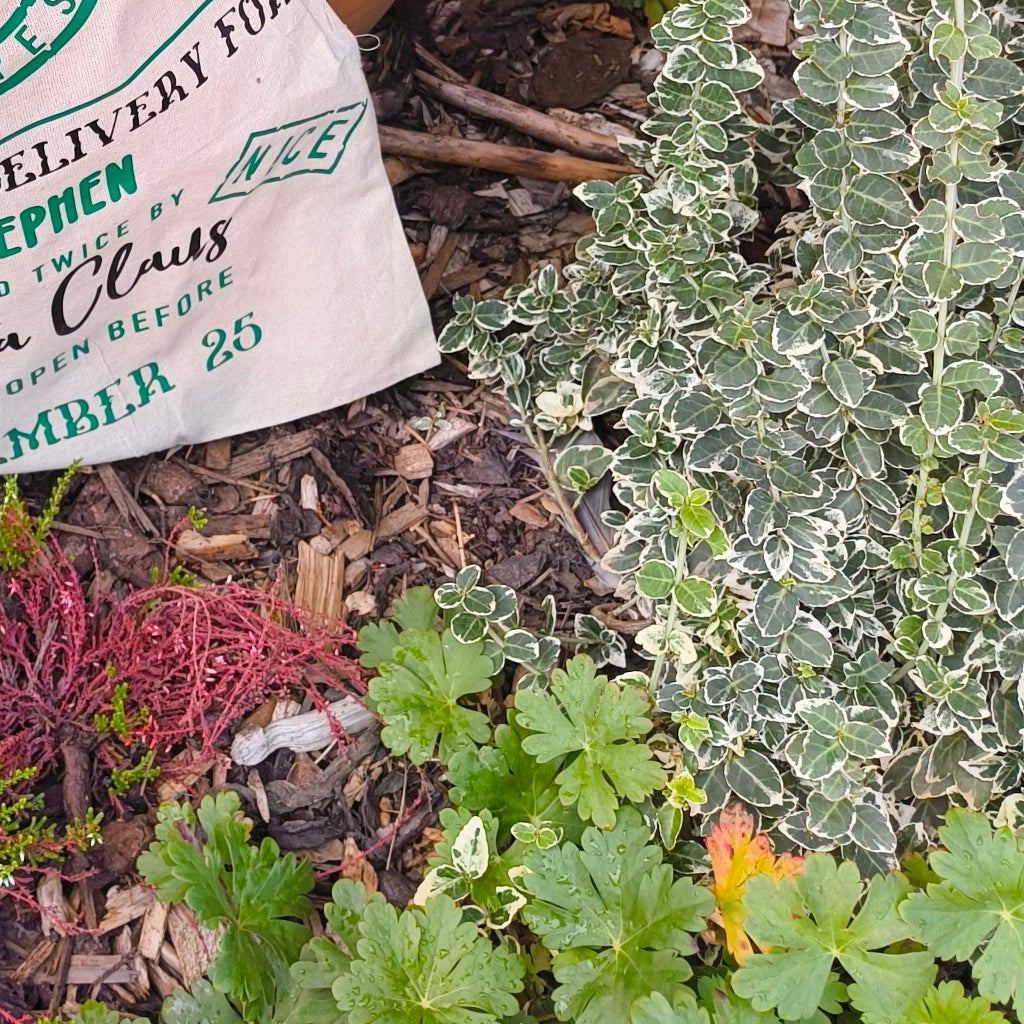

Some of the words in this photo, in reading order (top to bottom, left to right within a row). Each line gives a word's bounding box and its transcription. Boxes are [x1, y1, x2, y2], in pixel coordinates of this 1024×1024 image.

[231, 118, 350, 185] NICE
[32, 219, 130, 283] TWICE
[150, 188, 184, 221] BY
[50, 216, 233, 337] Claus
[5, 337, 91, 395] OPEN
[107, 265, 234, 342] BEFORE
[201, 311, 263, 373] 25
